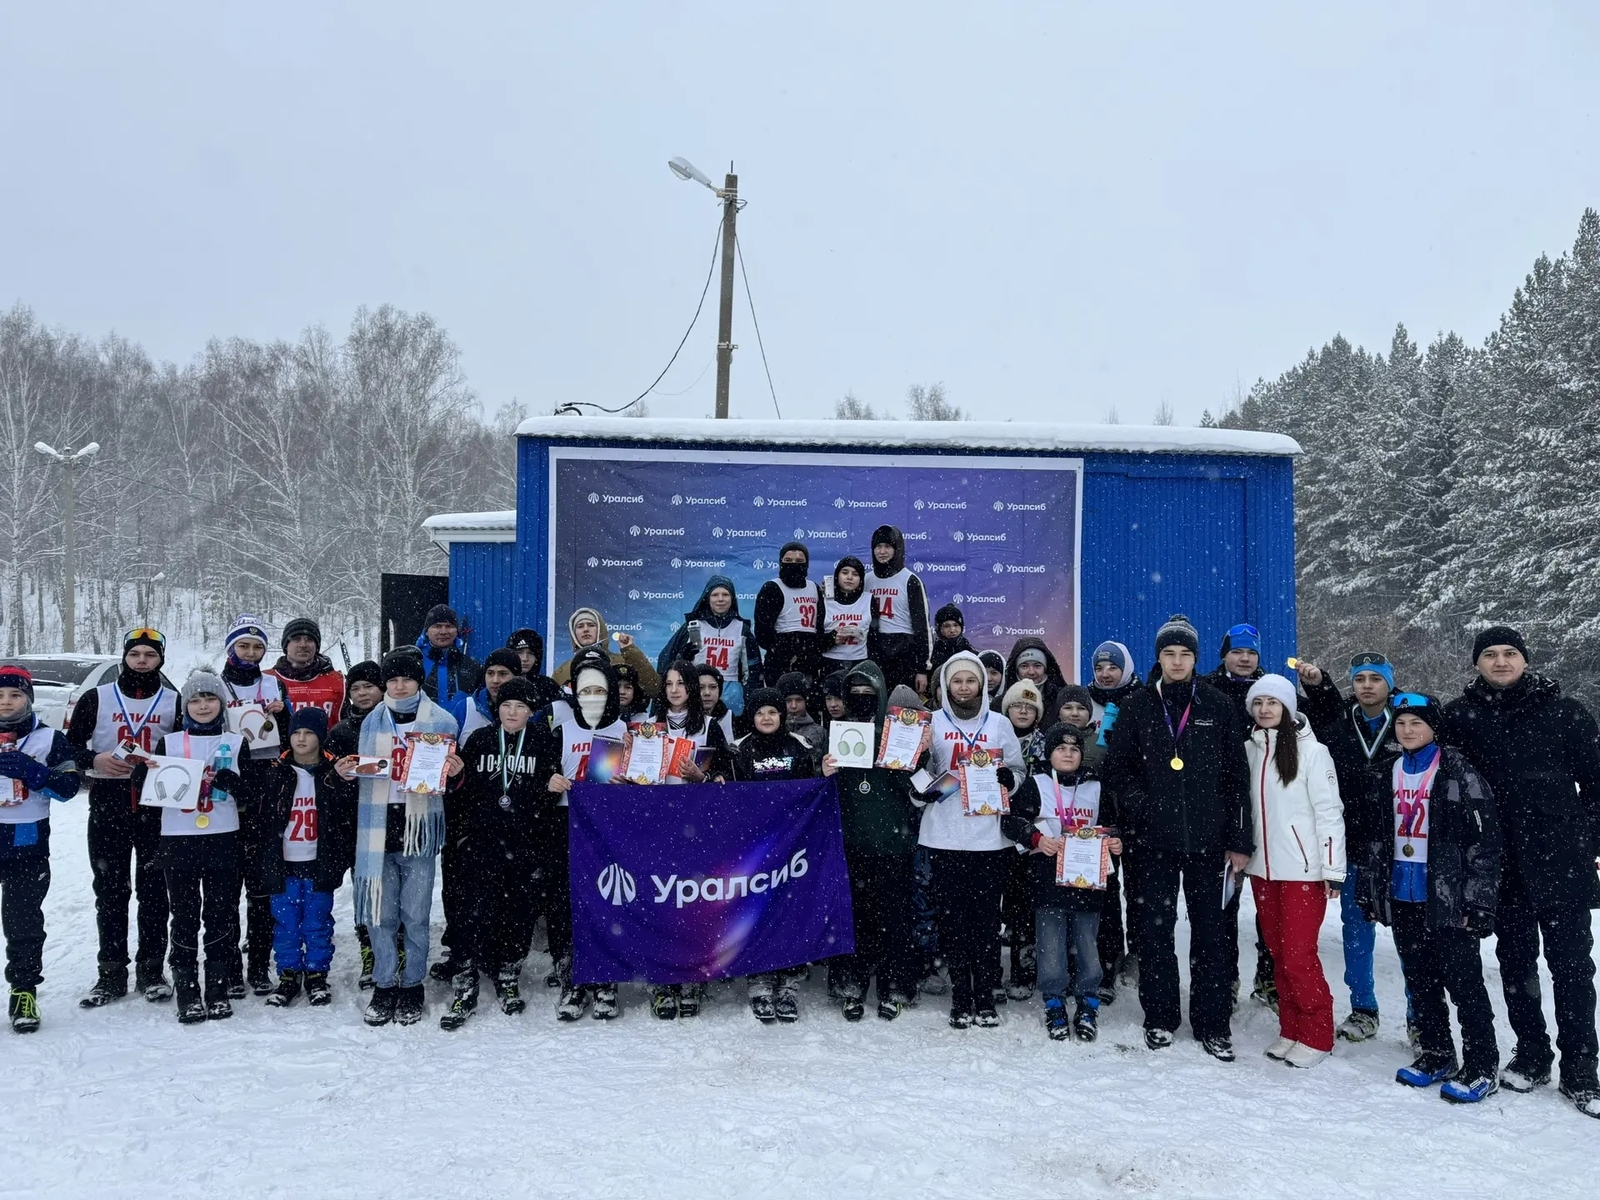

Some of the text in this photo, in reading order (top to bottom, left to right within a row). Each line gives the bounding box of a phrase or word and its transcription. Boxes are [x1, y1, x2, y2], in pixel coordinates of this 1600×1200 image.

[602, 494, 644, 504] Уралсиб
[685, 496, 727, 506] Уралсиб
[767, 498, 807, 507] Уралсиб
[848, 499, 887, 508] Уралсиб
[927, 501, 967, 510] Уралсиб
[1007, 502, 1046, 512] Уралсиб
[643, 527, 685, 537] Уралсиб
[726, 528, 767, 538] Уралсиб
[807, 530, 847, 539] Уралсиб
[902, 531, 927, 540] лсиб
[966, 532, 1006, 542] Уралсиб
[601, 558, 643, 568] Уралсиб
[684, 559, 726, 569] Уралсиб
[926, 563, 967, 573] Уралсиб
[1006, 564, 1046, 574] Уралсиб
[643, 590, 684, 600] Уралсиб
[966, 595, 1006, 604] Уралсиб
[799, 605, 815, 628] 32
[832, 613, 863, 621] ИЛИШ
[605, 623, 642, 632] ралсиб
[1005, 626, 1046, 636] Уралсиб
[703, 637, 734, 646] ИЛИШ
[706, 647, 729, 670] 54
[572, 742, 590, 752] ИЛ
[294, 797, 314, 807] ЛИ
[289, 809, 318, 841] 29
[1396, 802, 1427, 839] 22
[651, 848, 809, 909] Уралсиб
